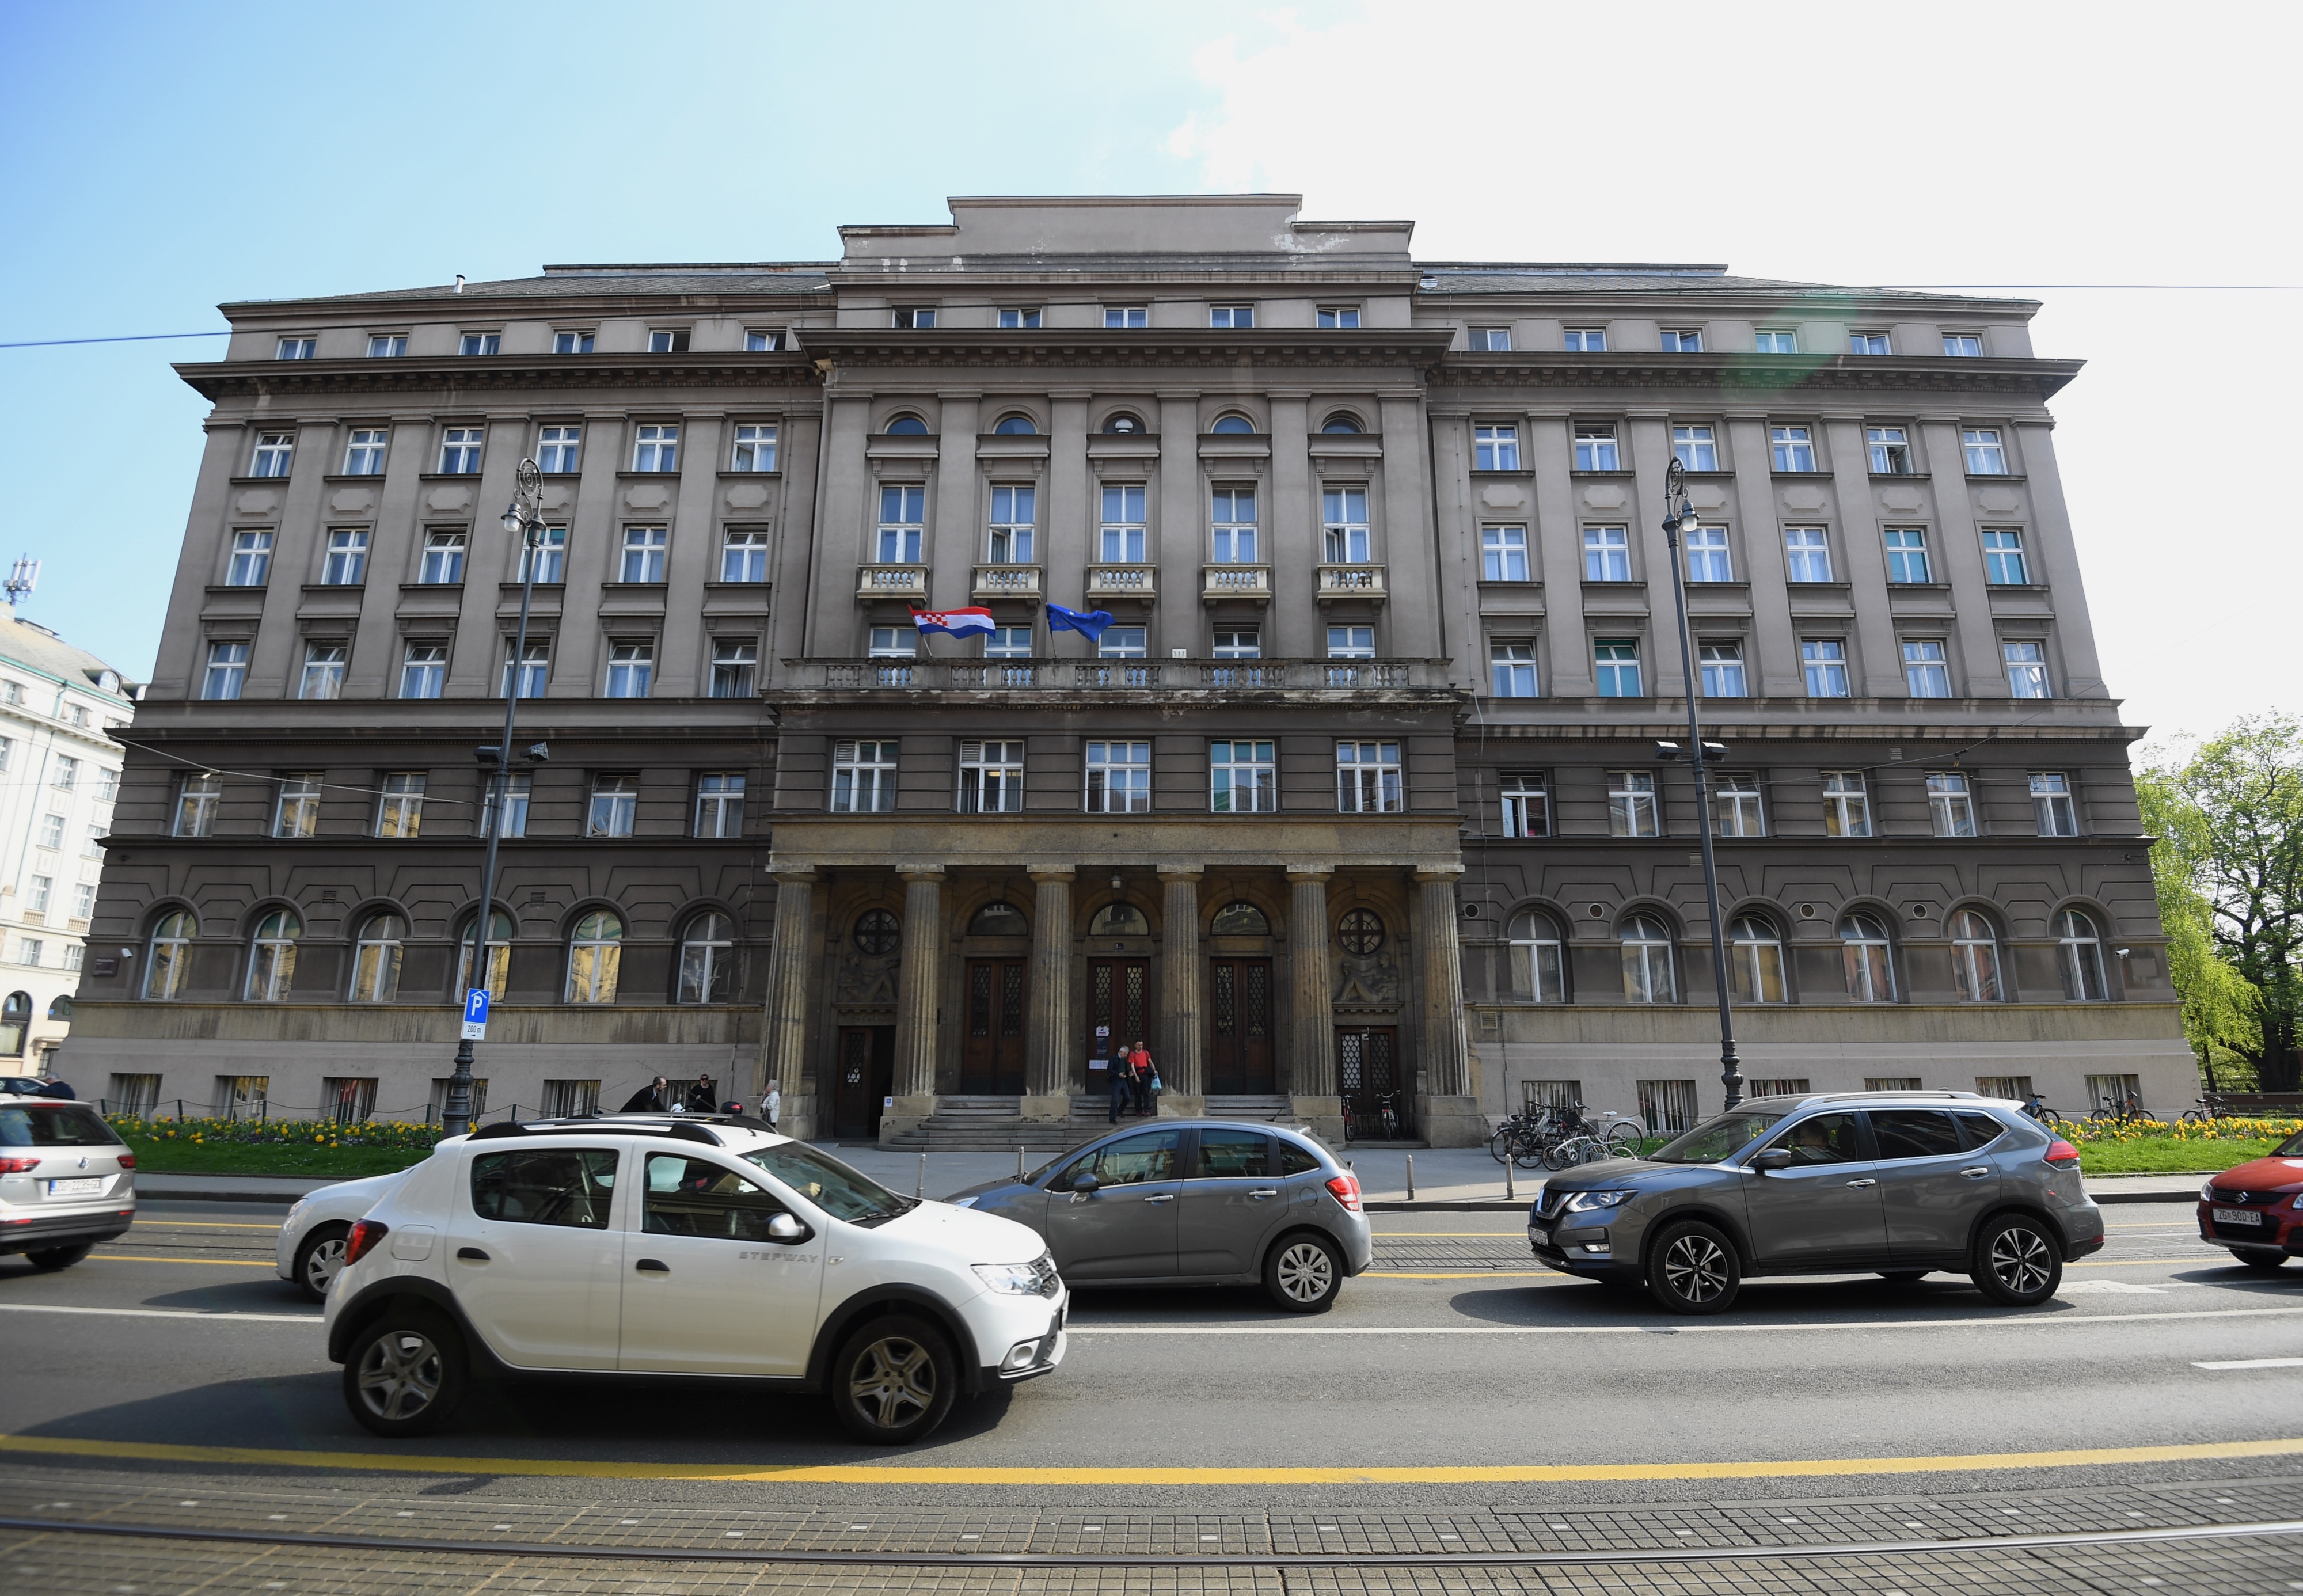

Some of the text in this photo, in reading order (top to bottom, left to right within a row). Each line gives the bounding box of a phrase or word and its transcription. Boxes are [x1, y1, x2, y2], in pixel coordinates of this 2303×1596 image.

[471, 995, 483, 1016] P
[467, 1025, 477, 1033] 200
[58, 1181, 66, 1191] ZG
[2218, 1210, 2260, 1222] ZG 900-EA
[739, 1251, 819, 1263] STEPWAY
